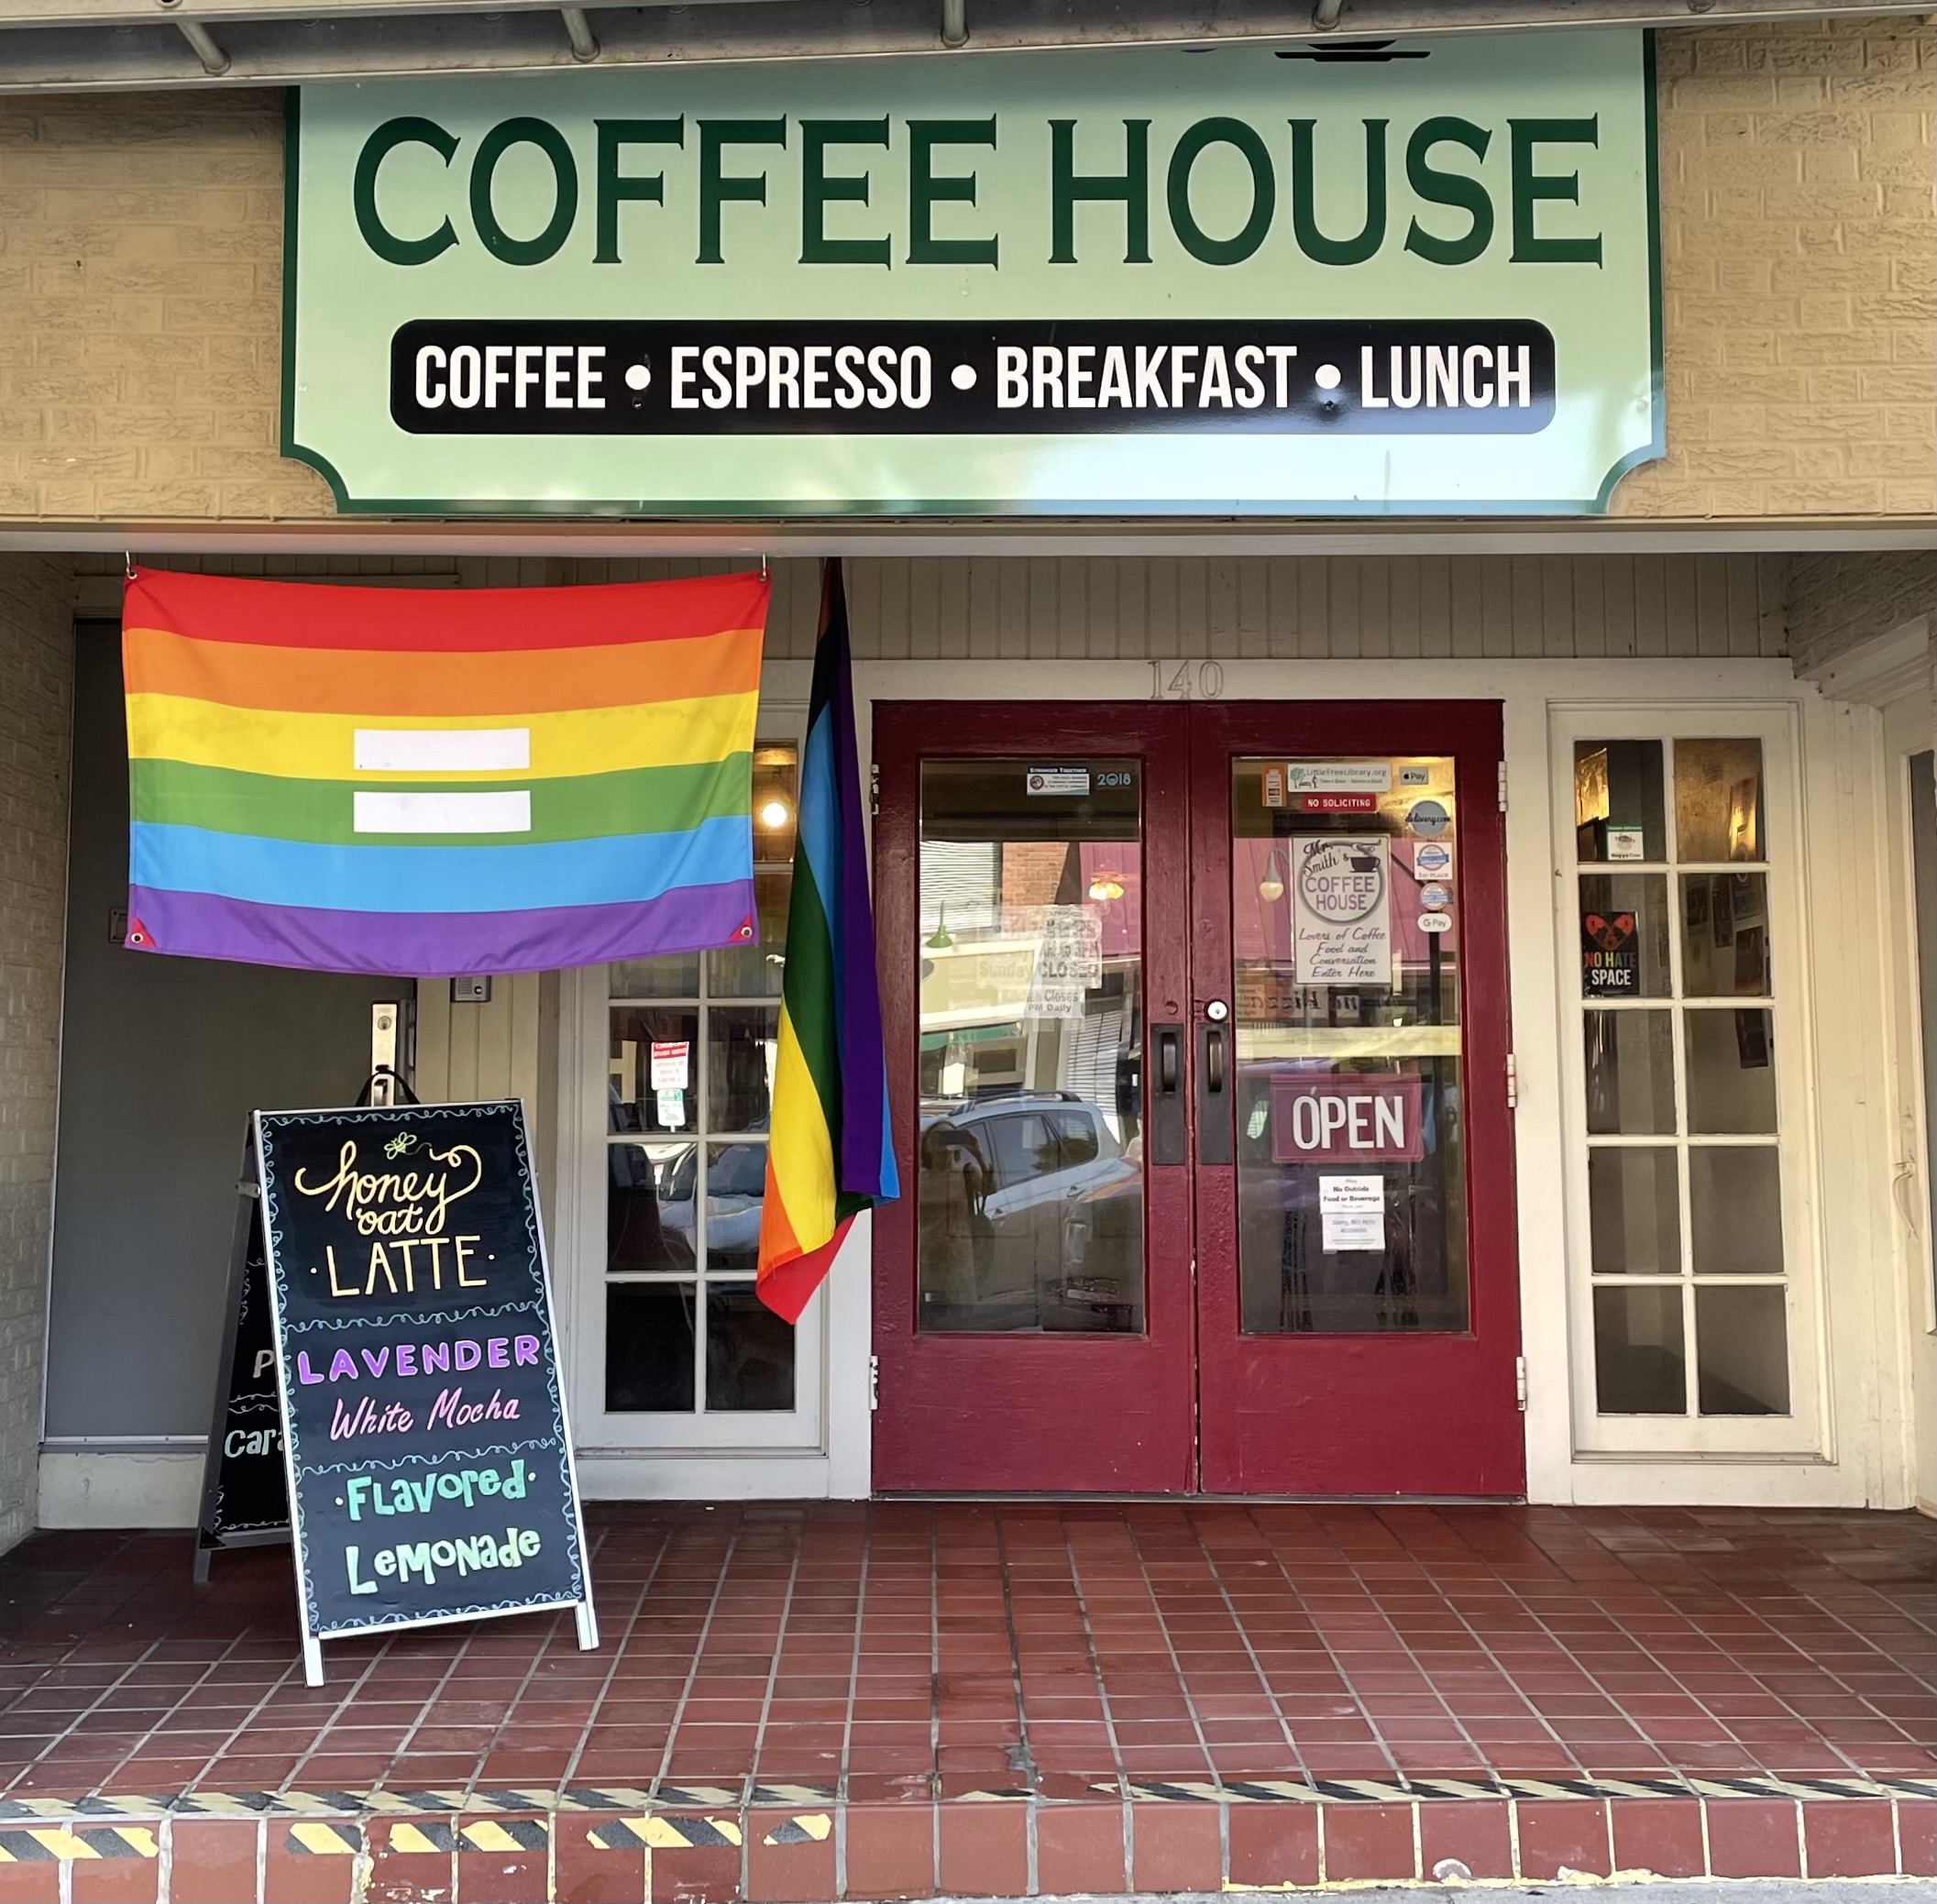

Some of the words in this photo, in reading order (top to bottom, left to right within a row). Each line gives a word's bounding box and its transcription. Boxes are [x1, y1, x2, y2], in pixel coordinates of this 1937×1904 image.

[354, 113, 999, 270] COFFEE
[1047, 112, 1604, 270] HOUSE
[414, 345, 607, 410] COFFEE
[670, 345, 932, 410] ESPRESSO
[996, 345, 1298, 410] BREAKFAST
[1360, 345, 1532, 410] LUNCH
[1147, 659, 1224, 700] 140
[1096, 773, 1132, 786] 2018
[1410, 772, 1426, 782] Pay
[1307, 798, 1319, 808] NO
[1322, 798, 1371, 808] SOLICITING
[1405, 812, 1450, 826] delivery.com
[1303, 848, 1350, 877] Smith's
[1304, 875, 1375, 894] COFFEE
[1315, 894, 1368, 911] HOUSE
[1432, 918, 1447, 928] Pay
[1298, 928, 1331, 941] Lovers
[1336, 928, 1350, 941] of
[1352, 927, 1387, 941] Coffee
[1316, 941, 1346, 954] Food
[1348, 943, 1370, 953] and
[1309, 953, 1377, 965] Conversation
[1584, 952, 1602, 968] NO
[1605, 952, 1637, 968] HATE
[1039, 961, 1099, 978] CLOSED
[1311, 965, 1343, 978] Enter
[1348, 965, 1376, 978] Here
[1591, 969, 1632, 985] SPACE
[1044, 988, 1079, 1002] Closes
[1047, 1004, 1072, 1013] Daily
[1292, 1095, 1405, 1150] OPEN
[294, 1139, 482, 1236] honey
[356, 1203, 424, 1236] oat
[297, 1332, 541, 1386] LAVENDER
[329, 1396, 415, 1442] White
[425, 1387, 521, 1431] Mocha
